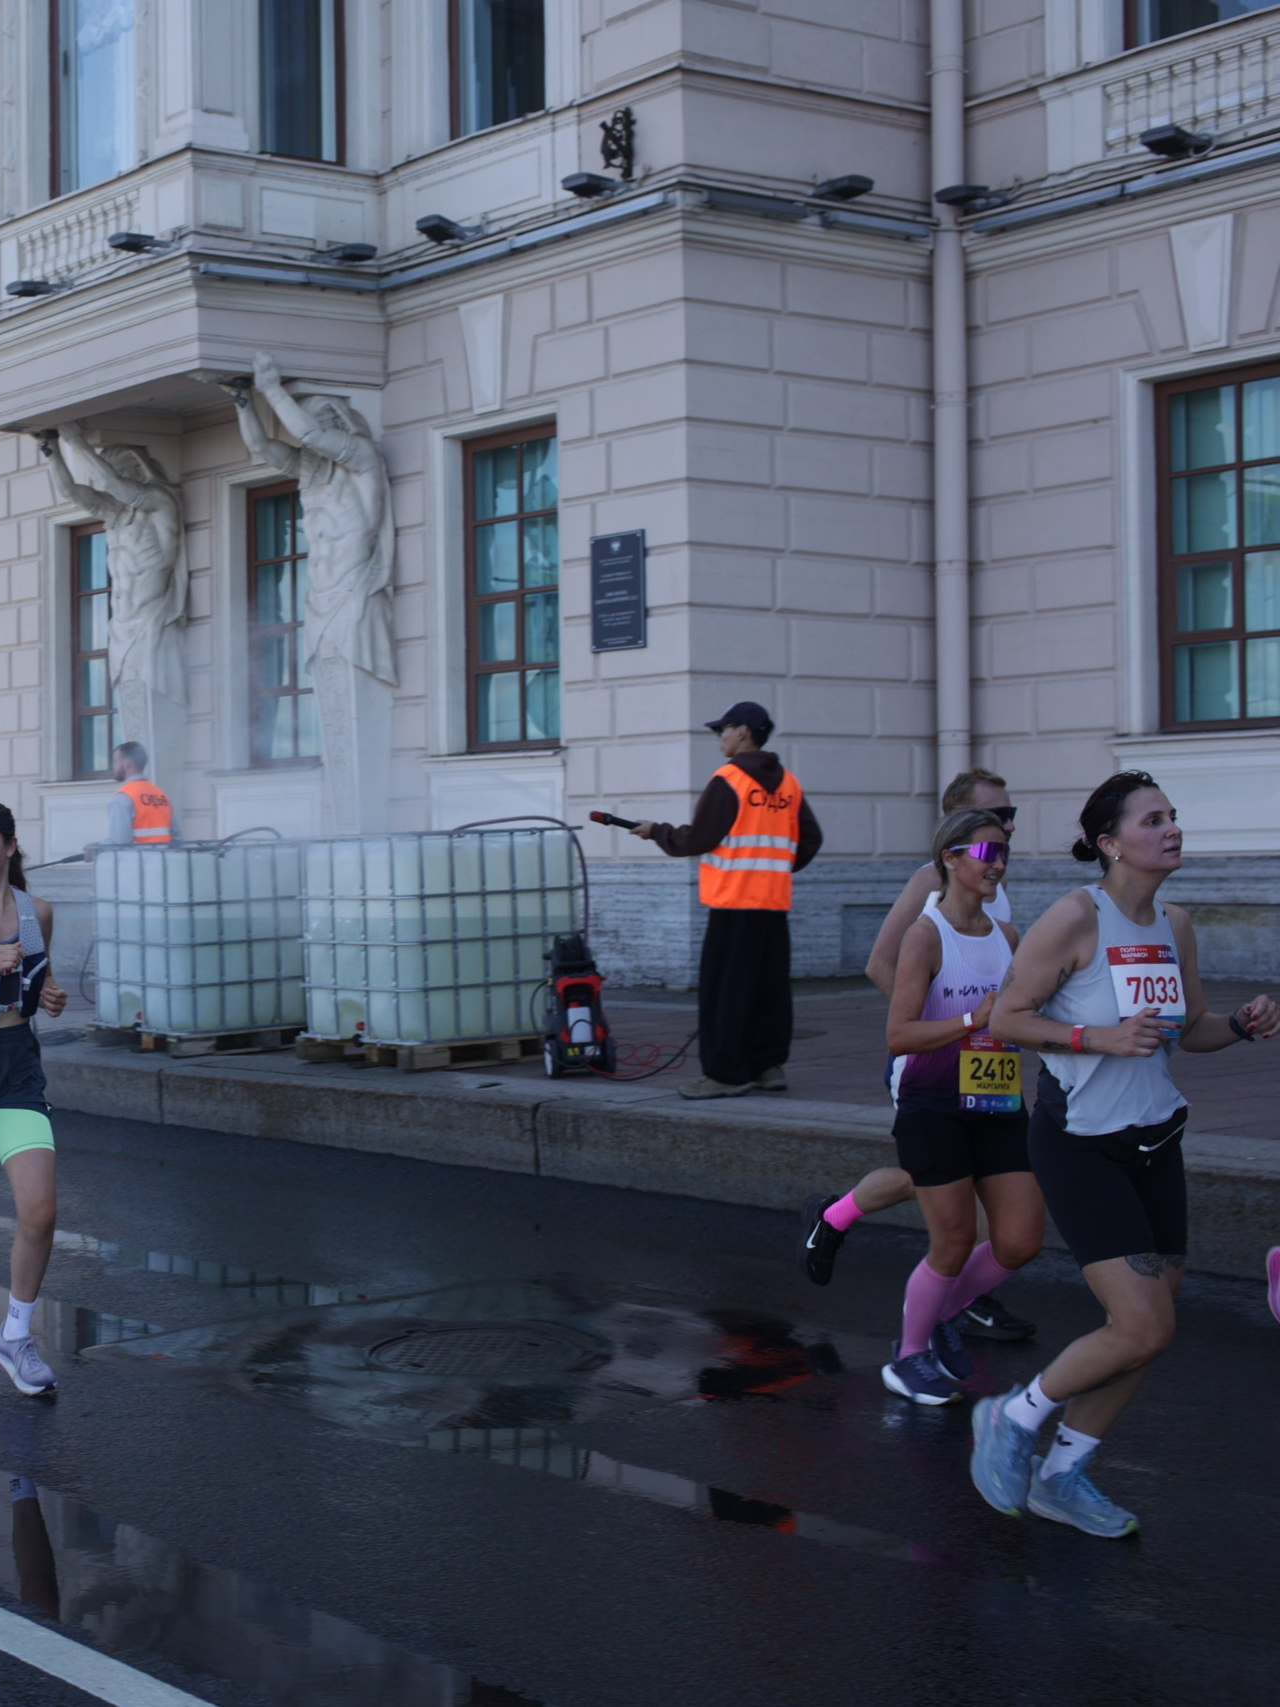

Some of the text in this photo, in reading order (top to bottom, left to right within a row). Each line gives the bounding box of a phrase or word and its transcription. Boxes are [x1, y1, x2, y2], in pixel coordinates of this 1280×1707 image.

[1126, 976, 1179, 1004] 7033
[970, 1057, 1016, 1081] 2413
[966, 1095, 976, 1108] D
